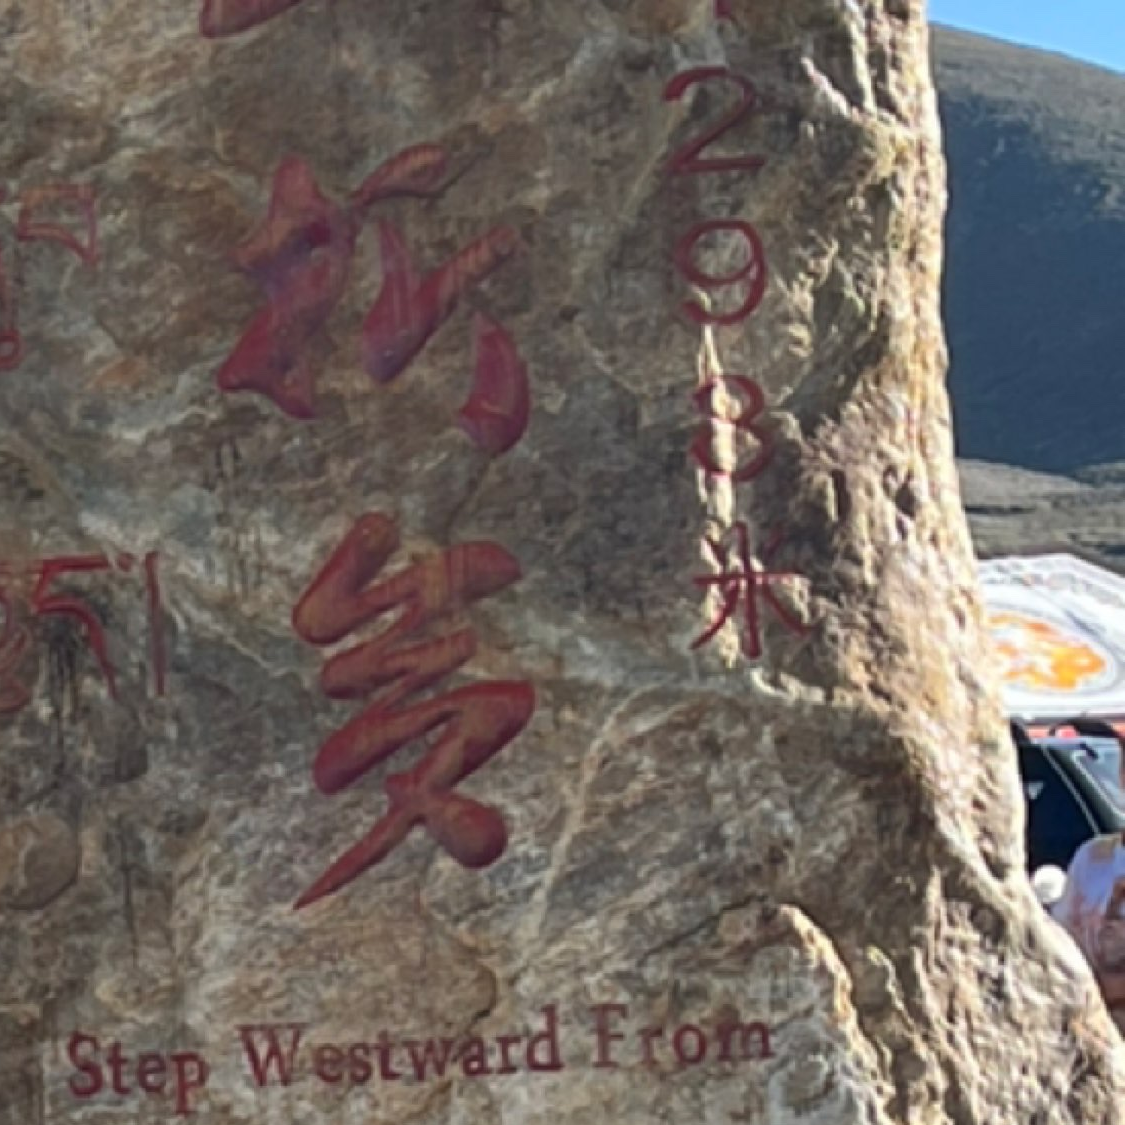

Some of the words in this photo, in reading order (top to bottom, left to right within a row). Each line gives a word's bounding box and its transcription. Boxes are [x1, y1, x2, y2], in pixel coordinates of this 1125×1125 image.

[199, 0, 537, 909] 折多
[662, 0, 811, 660] 298米
[67, 1031, 209, 1115] Step
[239, 1006, 564, 1087] Westward
[592, 1003, 773, 1068] From
